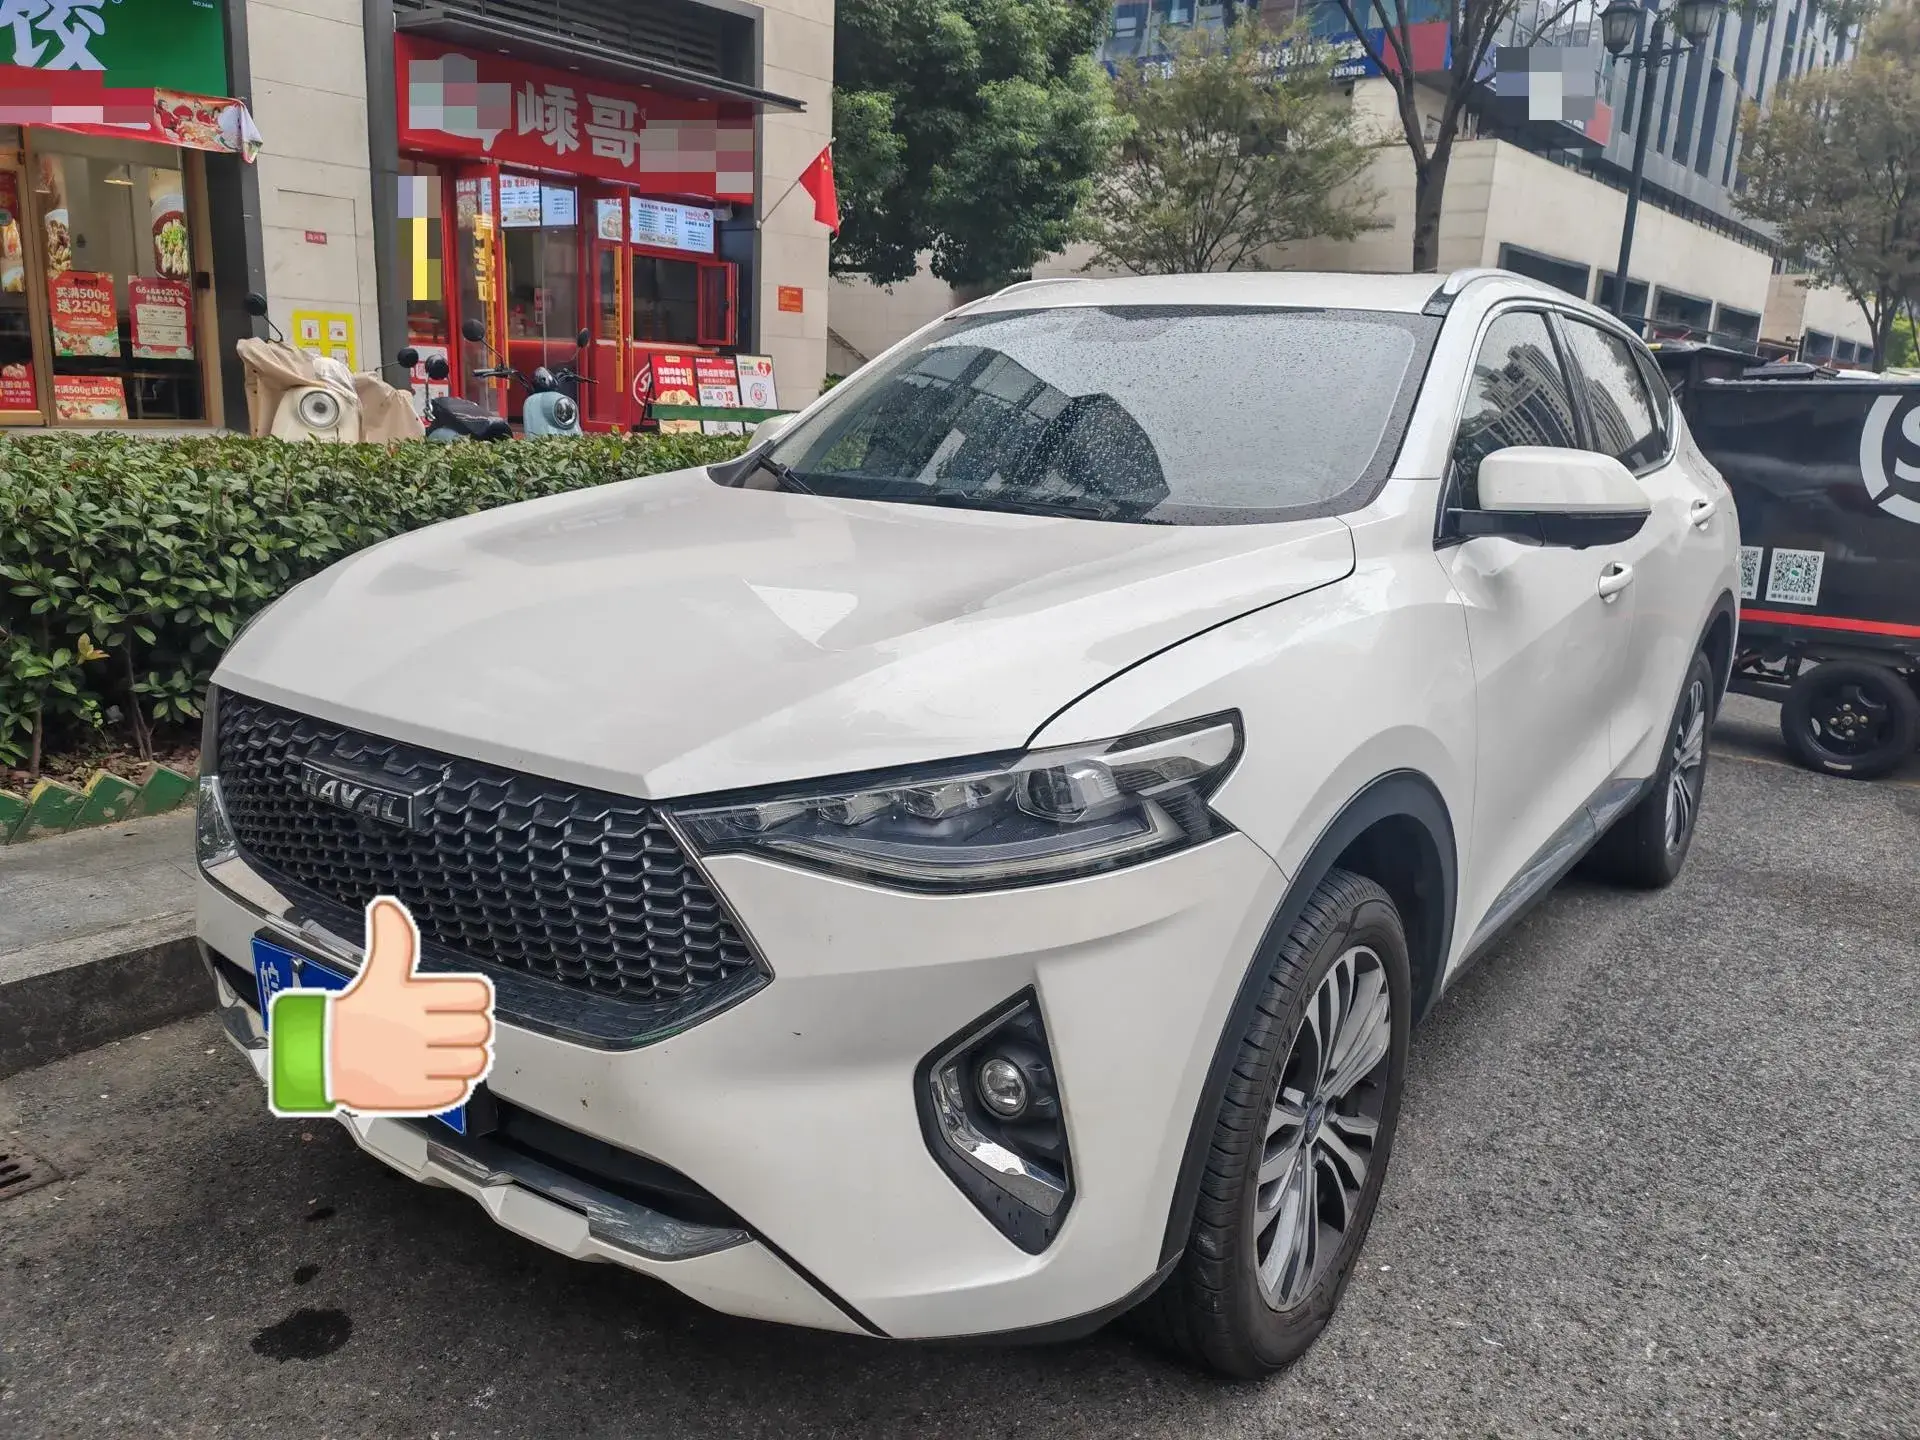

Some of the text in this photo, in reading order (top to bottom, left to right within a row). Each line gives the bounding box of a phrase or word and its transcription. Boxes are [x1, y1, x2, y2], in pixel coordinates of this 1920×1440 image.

[516, 80, 640, 168] 嵊哥
[56, 286, 110, 301] 买满500g
[56, 299, 112, 317] 送250g
[301, 769, 406, 824] HAVAL
